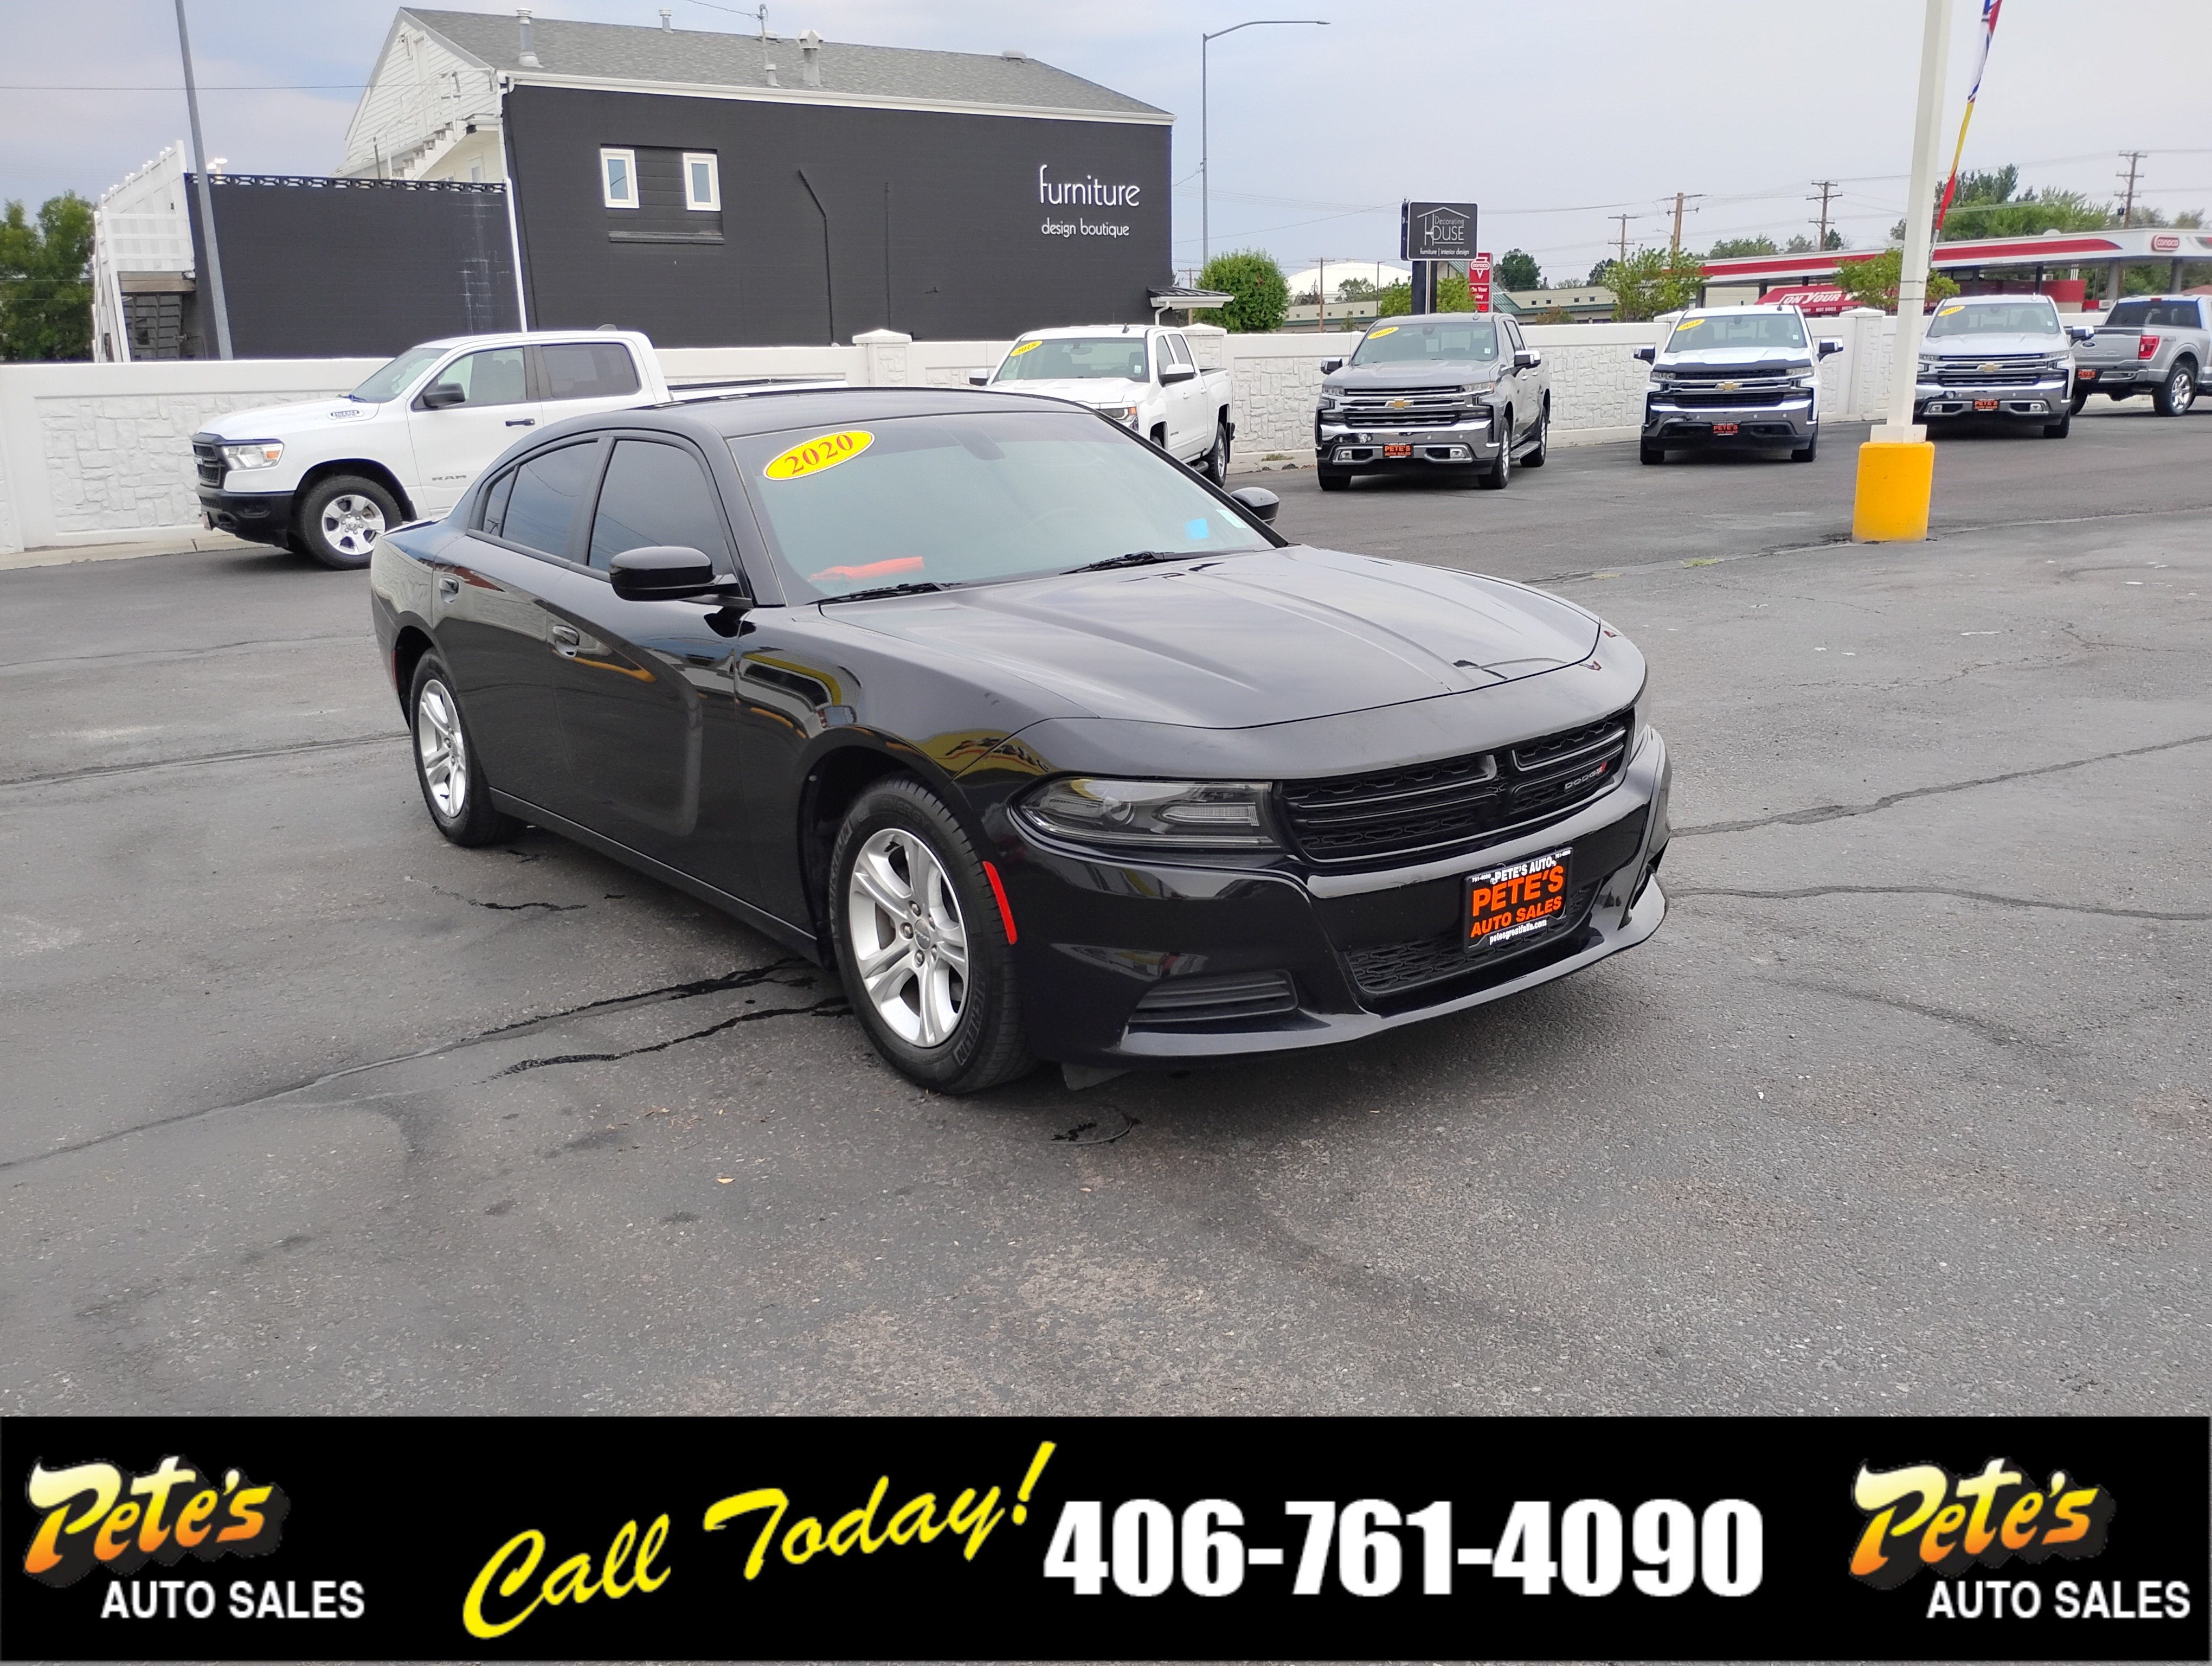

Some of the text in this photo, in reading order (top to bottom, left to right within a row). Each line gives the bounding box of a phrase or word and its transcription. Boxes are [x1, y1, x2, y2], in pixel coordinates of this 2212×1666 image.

[1040, 164, 1140, 207] furniture
[1041, 217, 1129, 239] design boutique
[1424, 213, 1464, 246] HOUSE
[1435, 215, 1464, 227] Decorating
[1456, 247, 1469, 256] design
[785, 434, 847, 475] 2020
[1565, 767, 1602, 789] DODGE
[1494, 856, 1552, 883] PETE'S AUTO
[1472, 866, 1564, 917] PETE'S
[1470, 896, 1562, 938] AUTO SALES
[1489, 919, 1547, 945] petesgreatfalls.com
